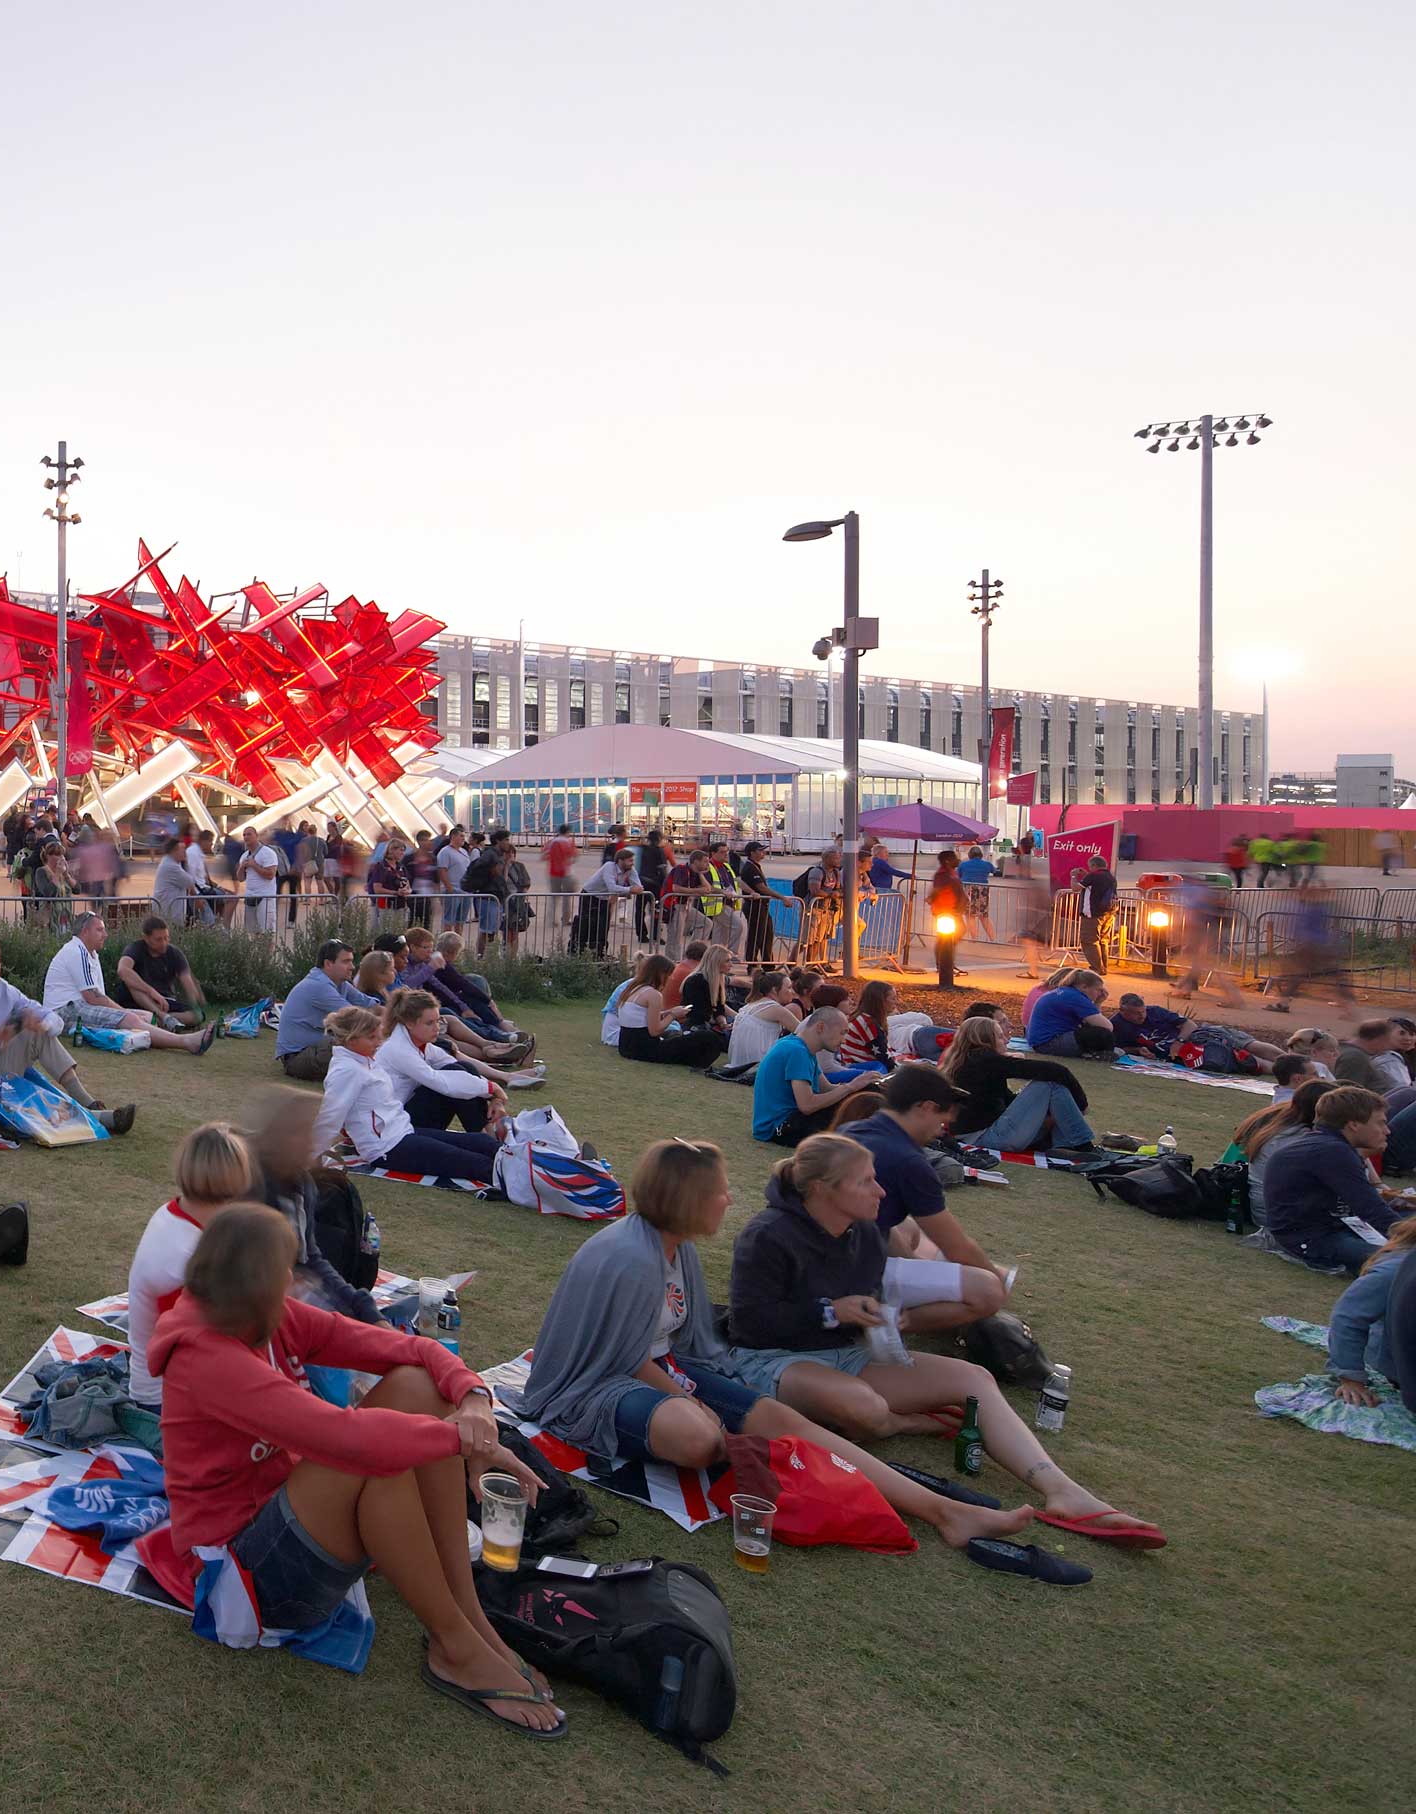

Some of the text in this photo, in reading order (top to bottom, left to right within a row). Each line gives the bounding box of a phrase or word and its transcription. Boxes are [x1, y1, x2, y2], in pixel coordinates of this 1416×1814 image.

[998, 734, 1007, 769] generation
[1053, 839, 1102, 857] Exit only
